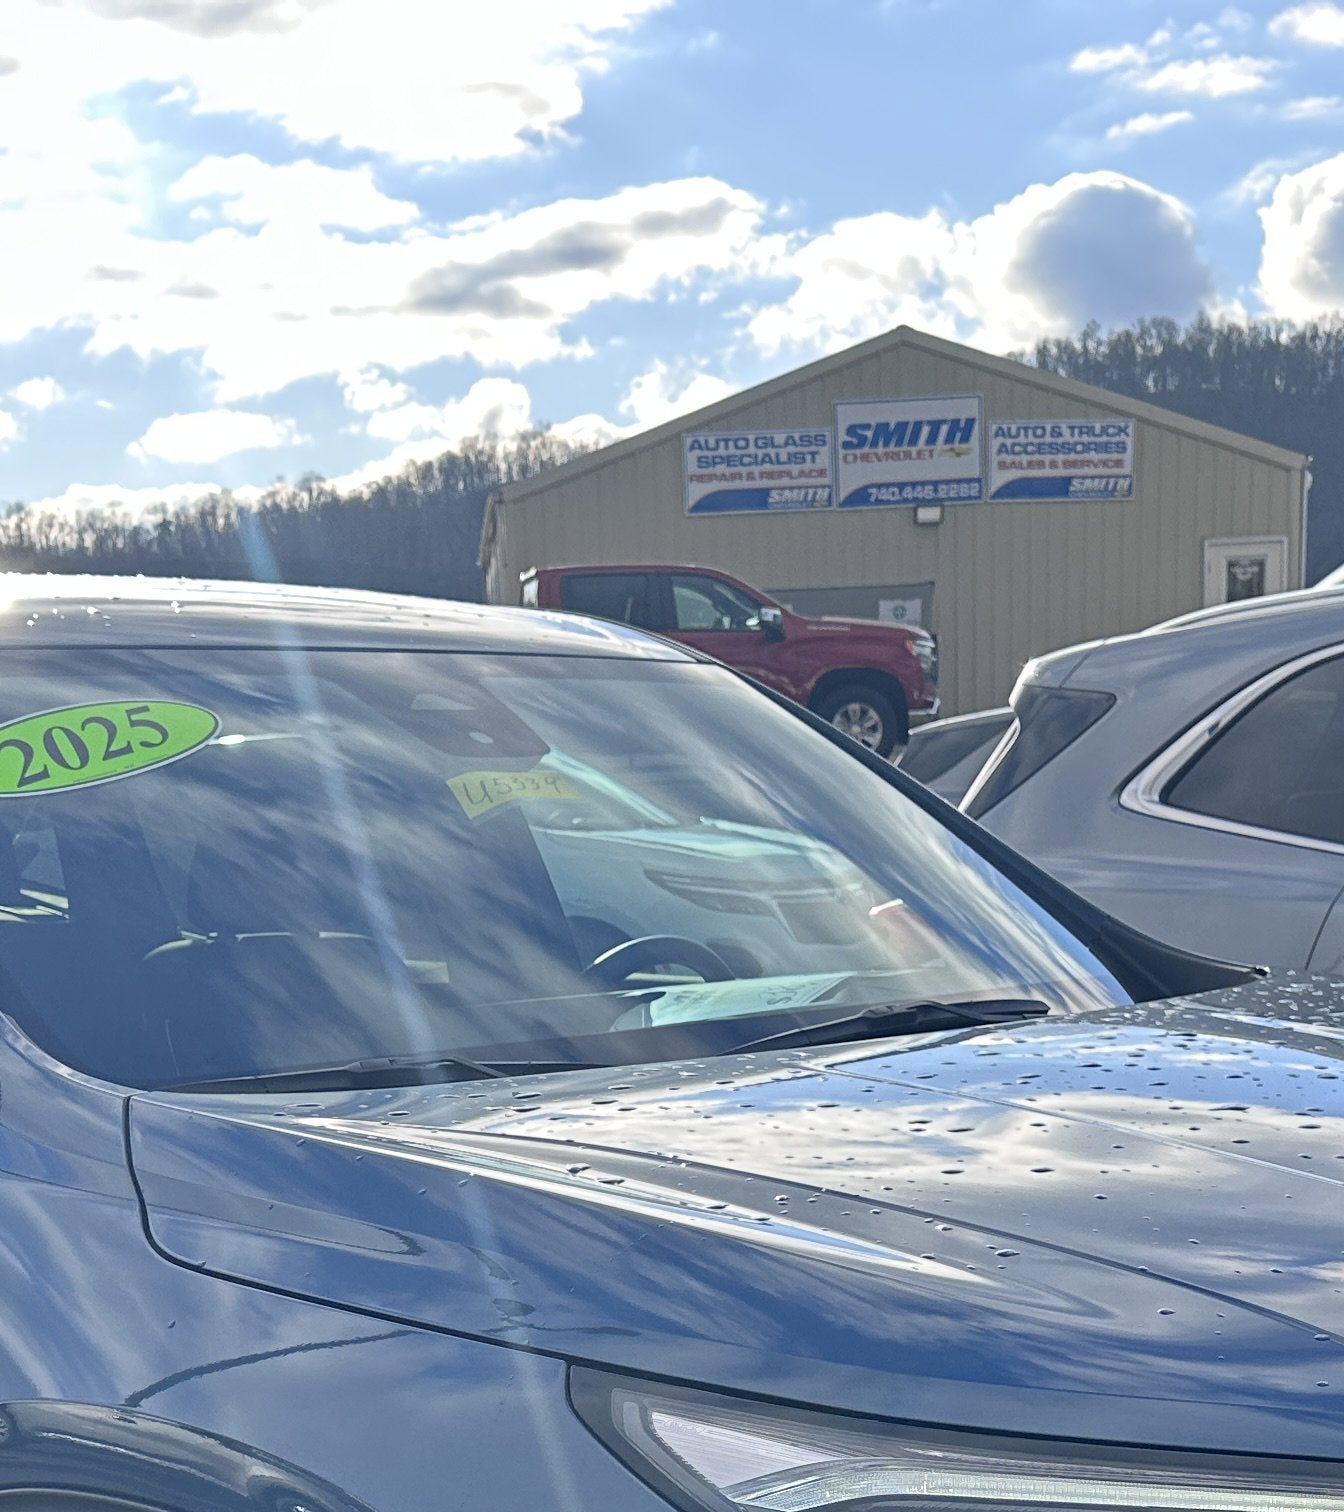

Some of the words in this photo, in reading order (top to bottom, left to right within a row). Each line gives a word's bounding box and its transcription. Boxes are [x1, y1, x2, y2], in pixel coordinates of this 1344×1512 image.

[842, 418, 976, 450] SMITH
[994, 425, 1046, 439] AUTO
[1050, 425, 1063, 438] &
[1067, 424, 1130, 438] TRUCK
[689, 436, 749, 452] AUTO
[754, 434, 827, 449] GLASS
[997, 441, 1127, 456] ACCESSORIES
[696, 451, 819, 469] SPECIALIST
[842, 448, 935, 464] CHEVROLET
[997, 459, 1046, 470] SALES
[1062, 458, 1124, 469] SERVICE
[689, 471, 743, 483] REPAIR
[759, 468, 827, 480] REPLACE
[1070, 477, 1131, 492] SMITH
[769, 487, 831, 502] SMITH
